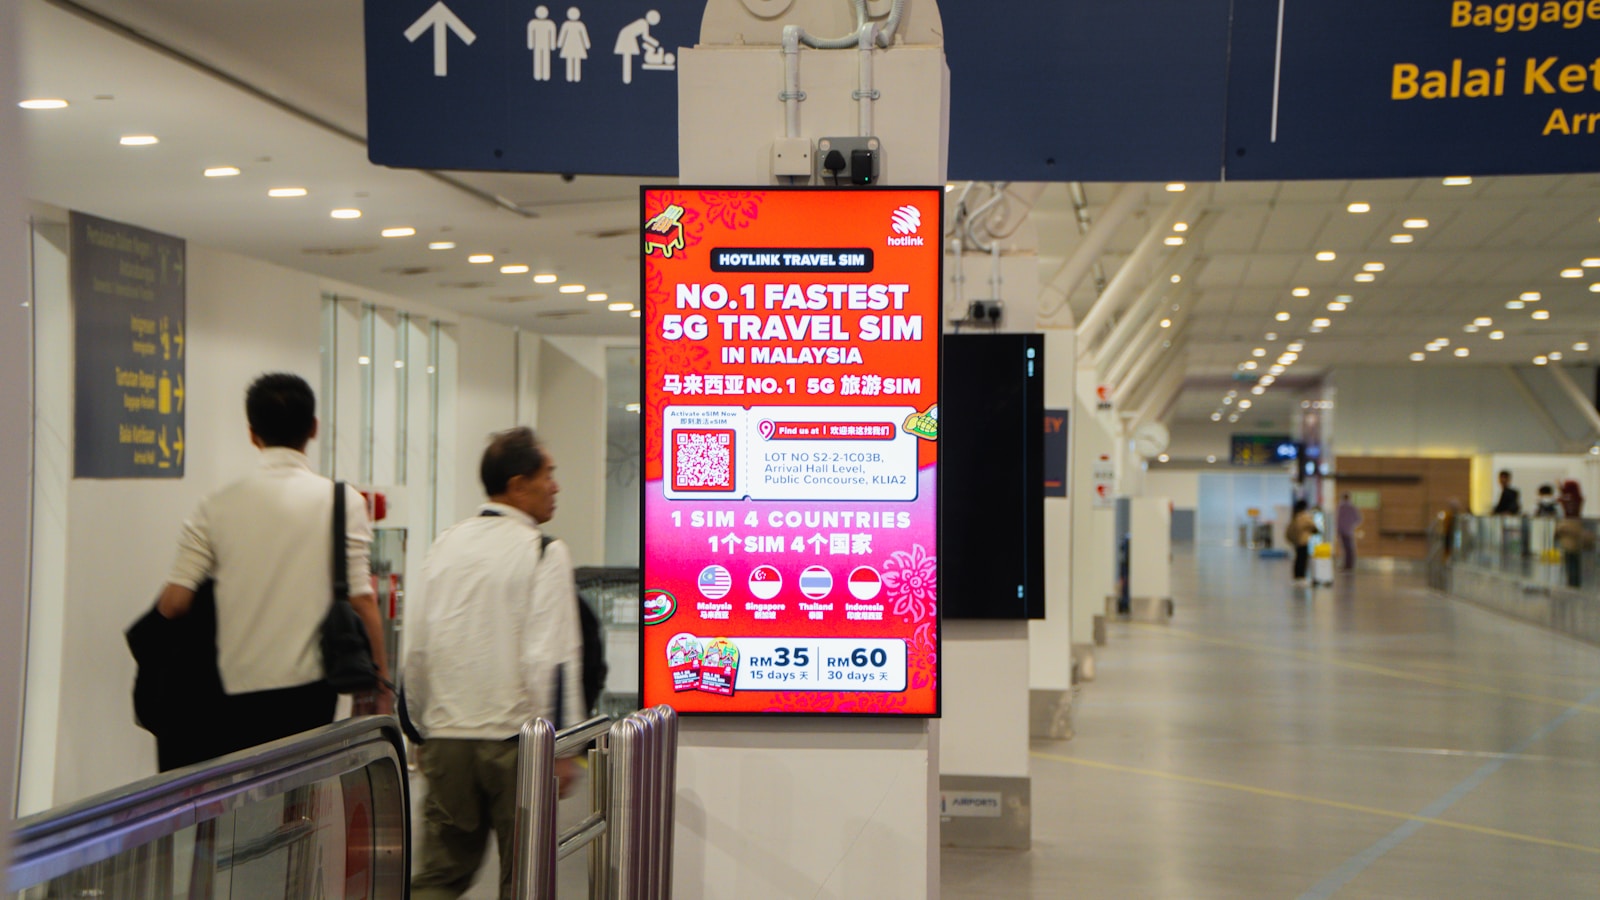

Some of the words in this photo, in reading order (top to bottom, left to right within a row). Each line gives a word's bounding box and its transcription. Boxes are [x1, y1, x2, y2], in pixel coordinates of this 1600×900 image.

[1391, 57, 1506, 100] Balai
[888, 236, 923, 246] hotlink
[720, 254, 780, 266] HOTLINK
[783, 254, 836, 266] TRAVEL
[839, 254, 865, 266] SIM
[676, 284, 755, 310] NO.1
[766, 284, 909, 310] FASTEST
[662, 315, 708, 340] 5G
[719, 315, 850, 340] TRAVEL
[859, 315, 922, 340] SIM
[722, 347, 745, 364] IN
[752, 347, 863, 364] MALAYSIA
[807, 377, 835, 394] 5G
[841, 375, 921, 396] 旅游SIM
[779, 427, 797, 435] Find
[830, 426, 889, 436] 欢迎来这找我们
[765, 453, 787, 462] LOT
[791, 453, 810, 462] NO
[813, 453, 885, 464] S2-2-1C03B,
[765, 464, 802, 473] Arrival
[806, 464, 828, 473] Hall
[833, 464, 866, 474] Level,
[765, 475, 800, 485] Public
[804, 475, 868, 486] Concourse,
[873, 475, 907, 485] KLIA2
[671, 511, 682, 528] 1
[691, 511, 735, 528] SIM
[745, 511, 759, 528] 4
[768, 511, 911, 528] COUNTRIES
[708, 534, 784, 554] 1个SIM
[791, 533, 873, 555] 4个国家
[697, 602, 732, 612] Malaysia
[746, 602, 786, 612] Singapore
[799, 602, 833, 611] Thailand
[846, 603, 884, 612] Indonesia
[750, 647, 809, 667] RM35
[828, 647, 887, 667] RM60
[750, 671, 763, 680] 15
[766, 670, 796, 681] days
[800, 671, 809, 680] 天
[828, 671, 843, 680] 30
[846, 670, 875, 681] days
[879, 671, 888, 680] 天
